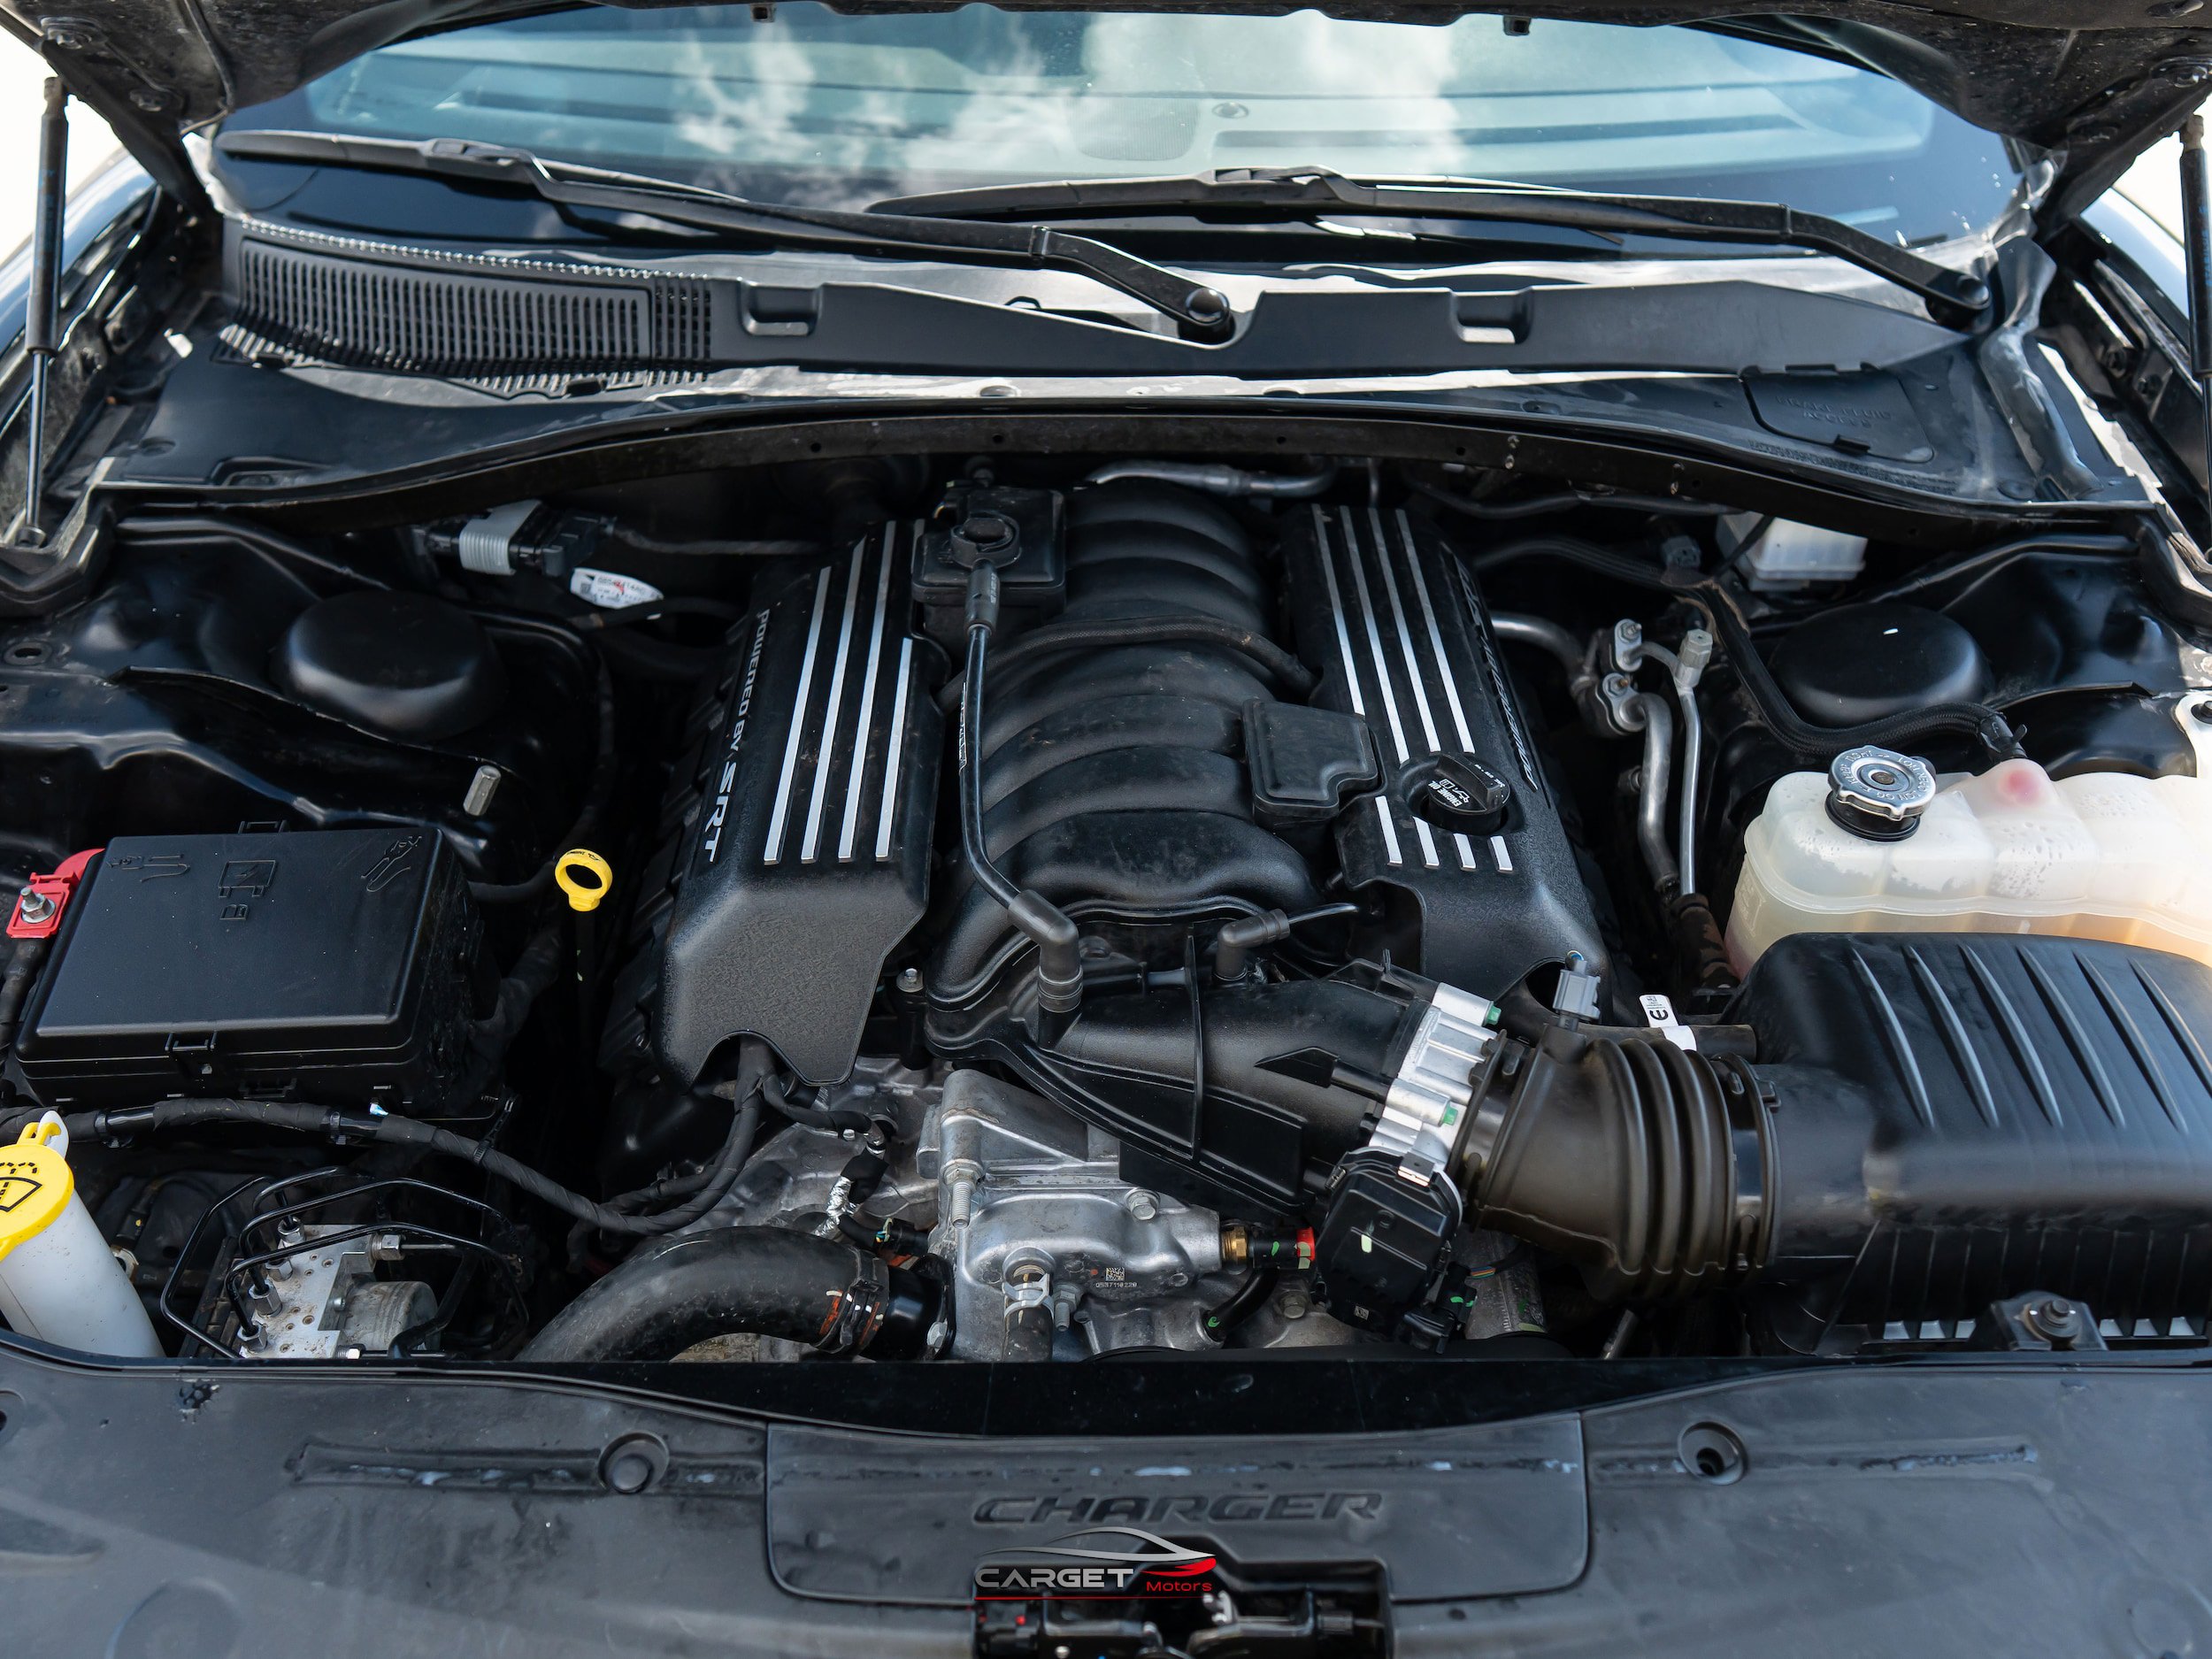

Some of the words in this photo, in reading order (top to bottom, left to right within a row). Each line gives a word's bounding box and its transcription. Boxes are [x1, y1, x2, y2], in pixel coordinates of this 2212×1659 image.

[737, 608, 770, 718] POWERED
[729, 719, 745, 752] BY
[1428, 780, 1440, 791] OIL
[1437, 787, 1463, 807] ENGINE
[703, 760, 737, 864] SRT
[972, 1492, 1385, 1525] CHARGER
